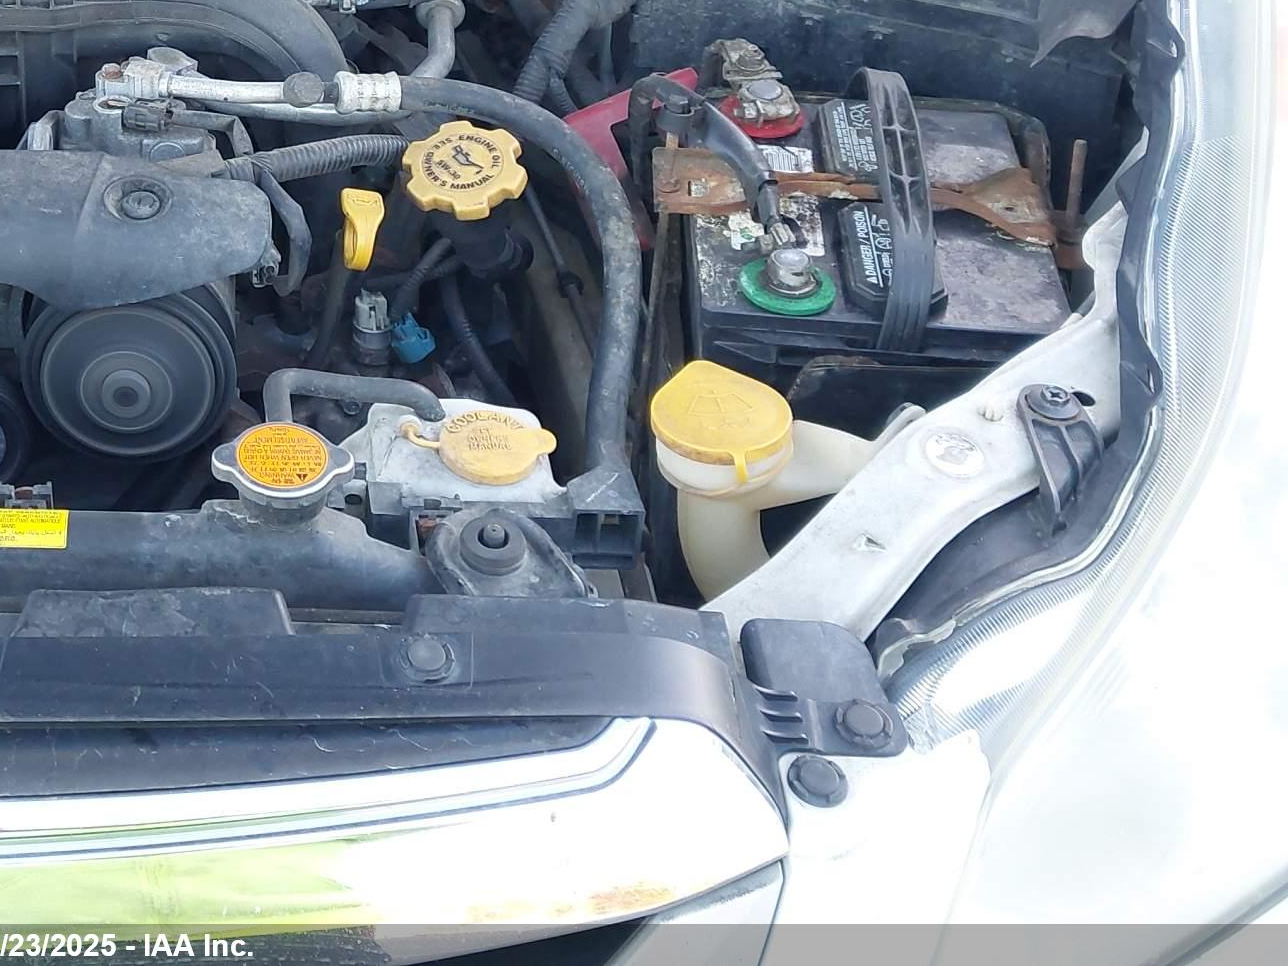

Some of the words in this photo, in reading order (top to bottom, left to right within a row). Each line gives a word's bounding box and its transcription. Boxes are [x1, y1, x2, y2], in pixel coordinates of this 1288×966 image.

[433, 137, 453, 150] SEE
[458, 134, 498, 154] ENGINE
[492, 155, 501, 168] OIL
[424, 151, 448, 187] OWNER'S
[436, 159, 462, 180] 5W-30
[450, 174, 495, 190] MANUAL
[852, 210, 870, 238] POISON
[859, 244, 878, 276] DANGER
[446, 411, 527, 434] COOLANT
